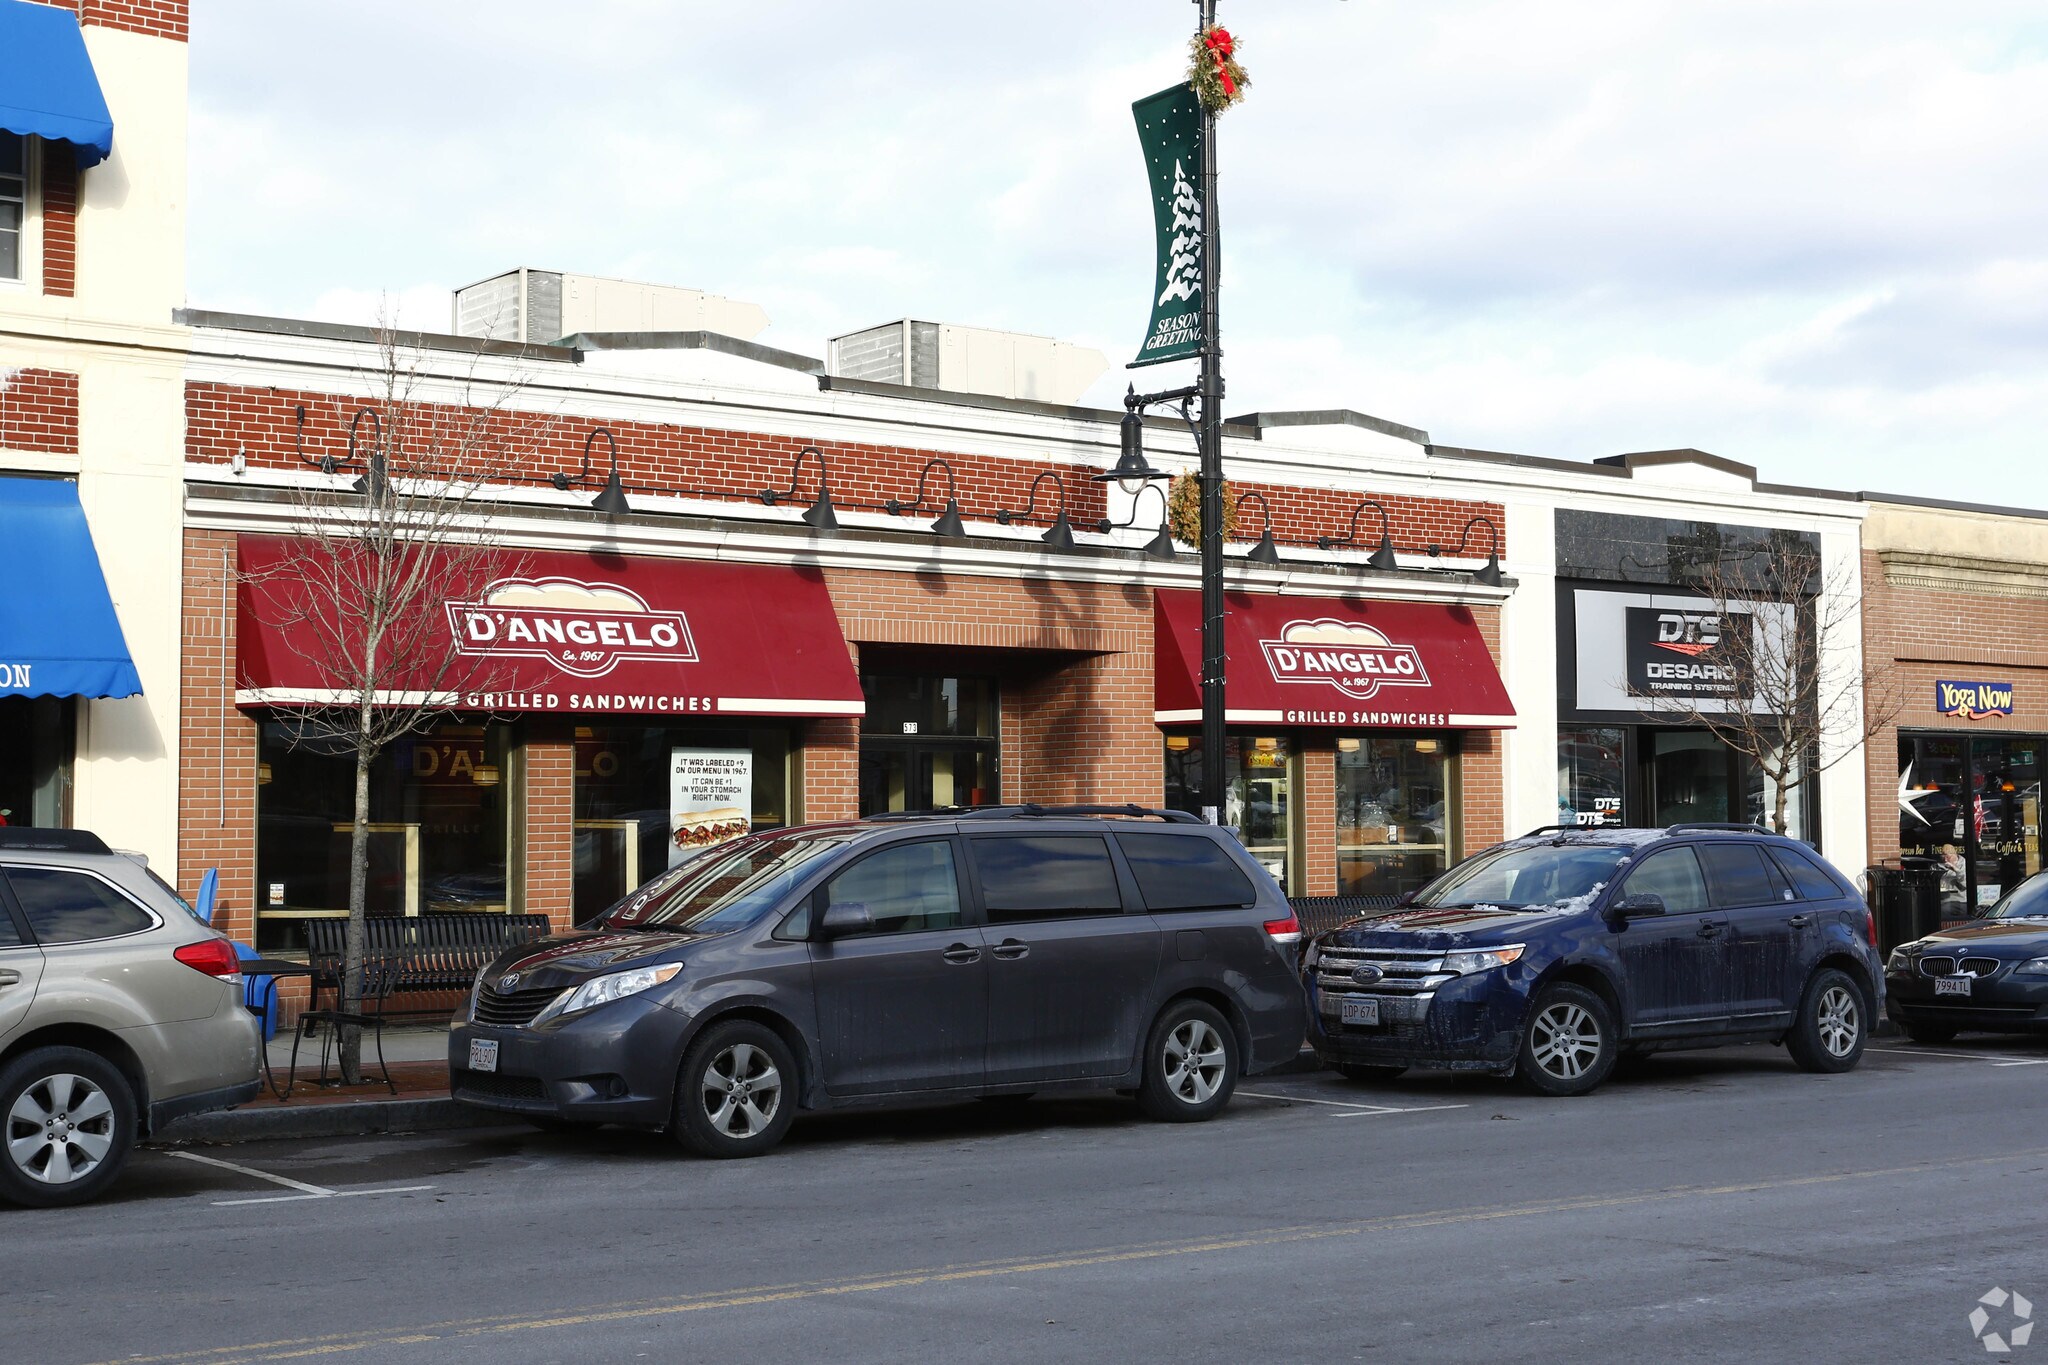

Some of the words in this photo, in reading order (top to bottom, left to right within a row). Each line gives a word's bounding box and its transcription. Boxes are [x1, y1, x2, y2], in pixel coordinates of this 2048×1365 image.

[465, 612, 679, 648] D'ANGELO
[1657, 614, 1721, 644] DTS
[580, 650, 605, 661] 1967
[1273, 648, 1415, 675] D'ANGELO
[1354, 677, 1369, 686] 1967
[1649, 682, 1692, 691] TRAINING
[467, 692, 559, 708] GRILLED
[569, 694, 711, 711] SANDWICHES
[1941, 683, 1976, 717] Yoga
[1978, 685, 2011, 710] Now
[1287, 711, 1346, 723] GRILLED
[1352, 711, 1445, 725] SANDWICHES
[681, 758, 688, 766] IT
[706, 759, 735, 767] LABELED
[703, 767, 722, 775] MENU
[1593, 797, 1621, 810] DTS
[1575, 812, 1606, 826] DTS
[1996, 841, 2017, 856] Coffee
[1936, 980, 1957, 991] 7994
[1957, 981, 1969, 992] TL
[1360, 1006, 1376, 1018] 674
